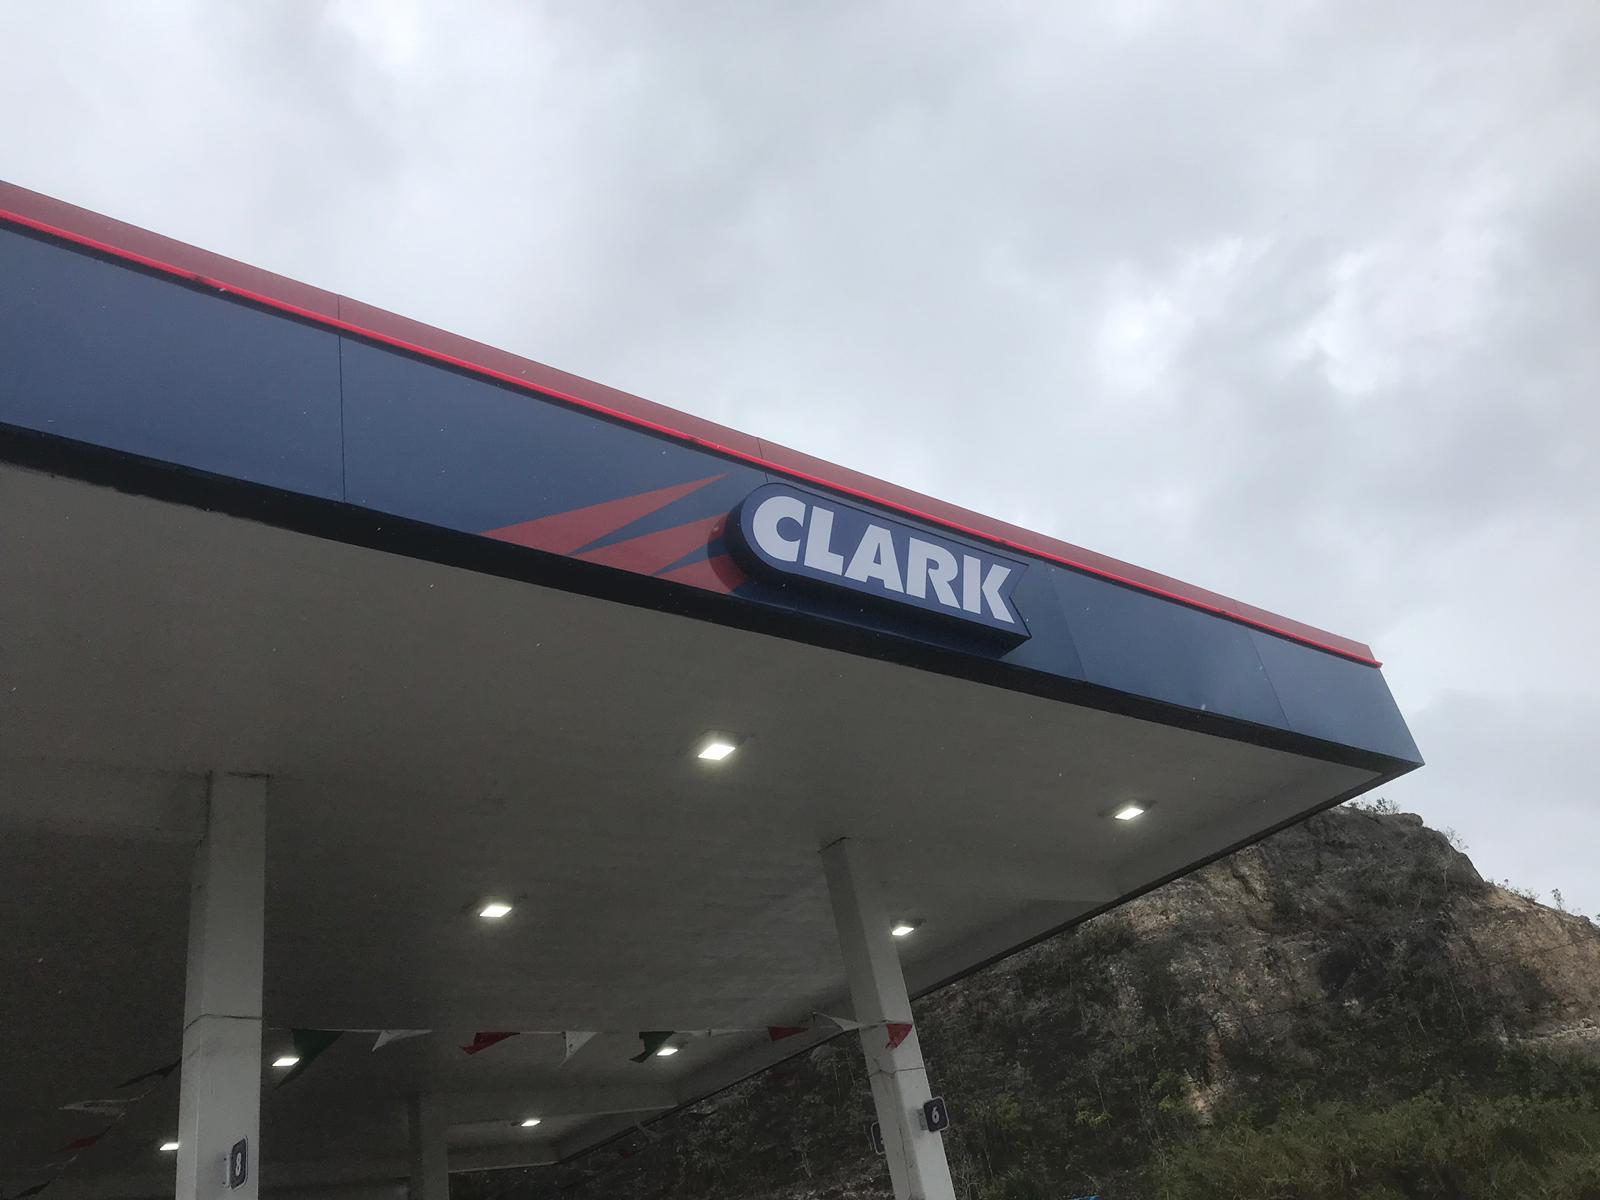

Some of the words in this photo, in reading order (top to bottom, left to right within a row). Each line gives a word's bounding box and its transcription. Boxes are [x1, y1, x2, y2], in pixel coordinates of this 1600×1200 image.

[752, 495, 1015, 624] CLARK
[931, 1106, 940, 1124] 6
[235, 1152, 242, 1177] 8
